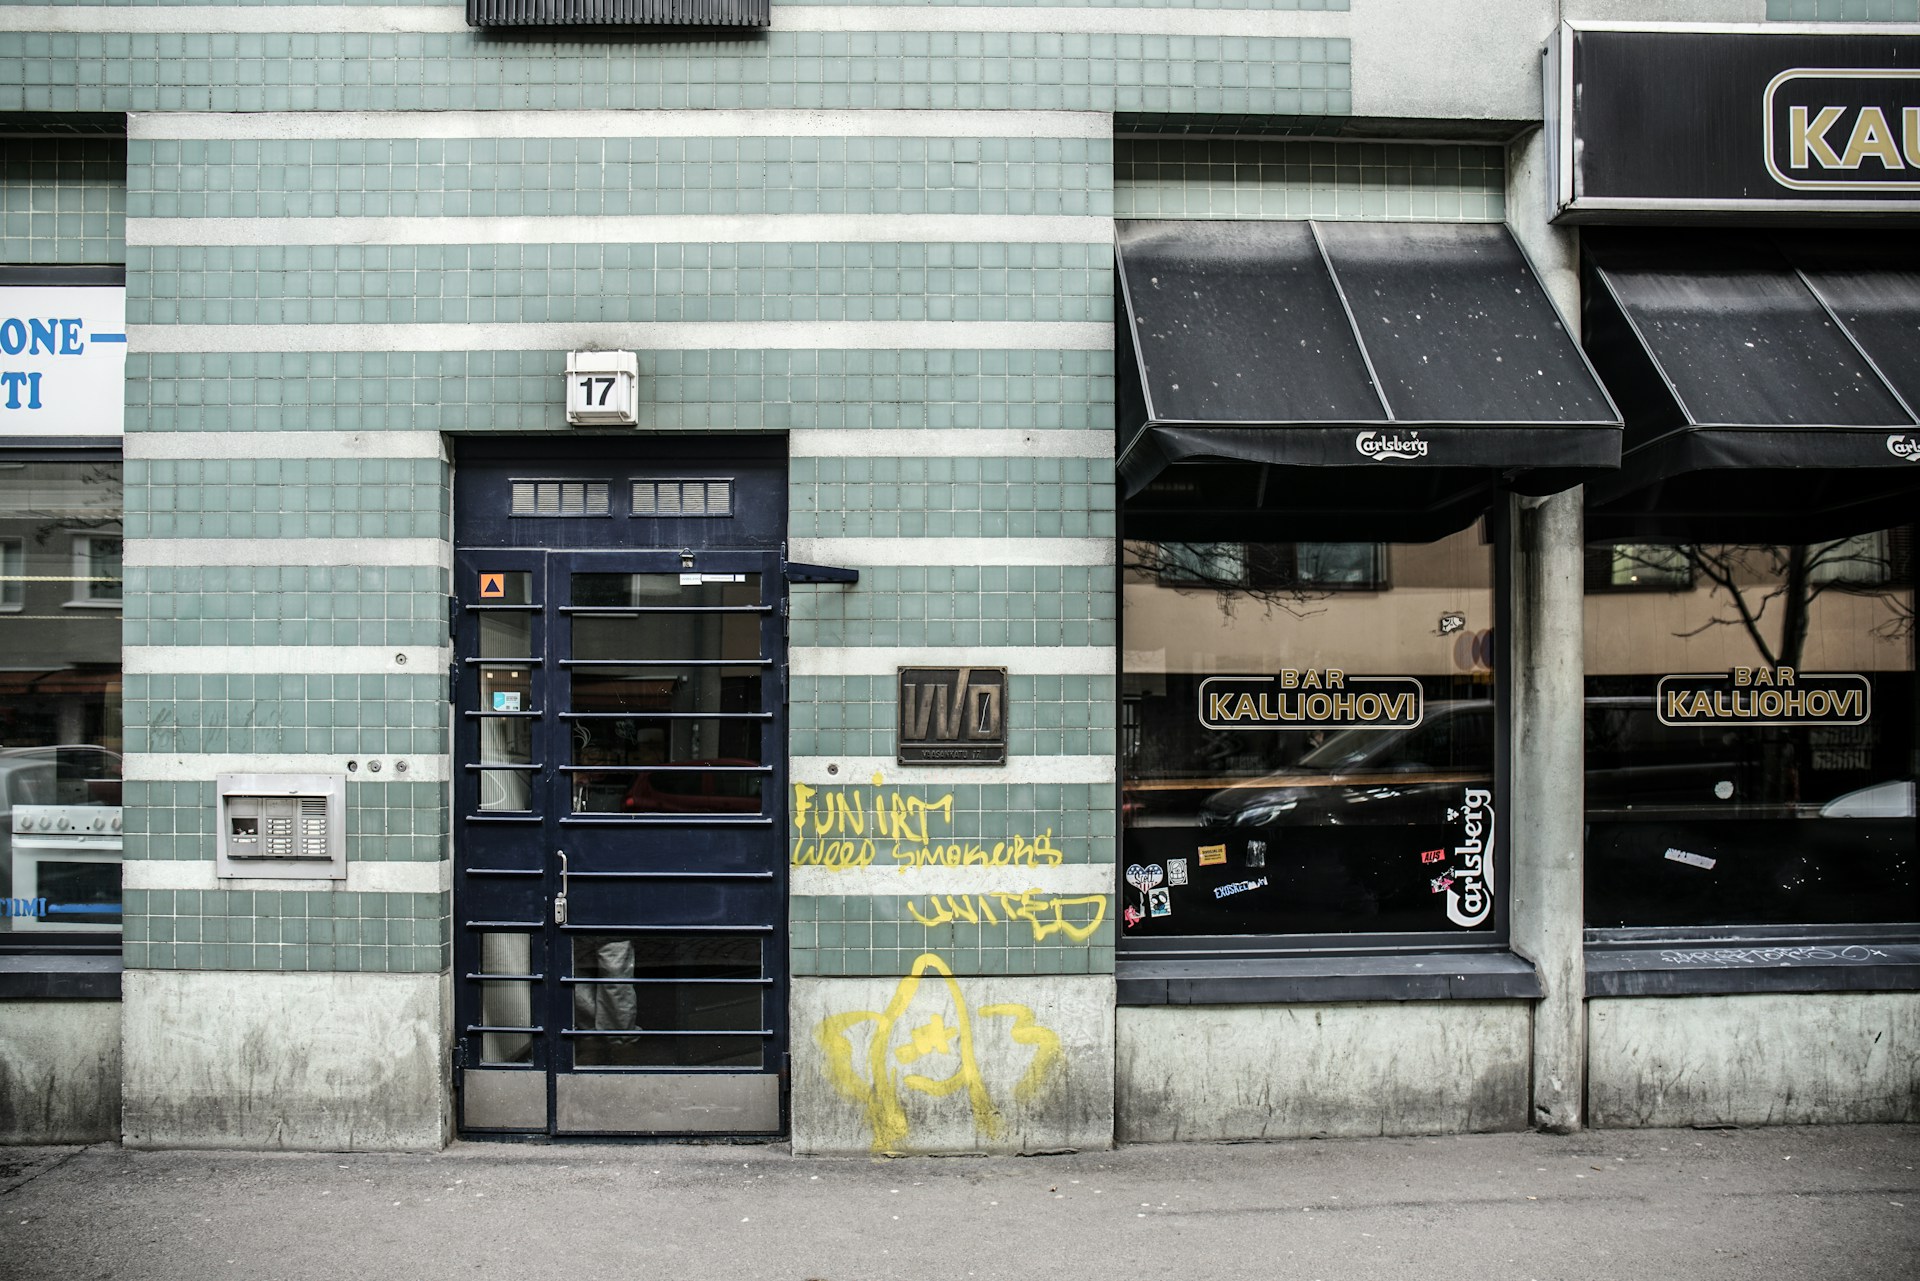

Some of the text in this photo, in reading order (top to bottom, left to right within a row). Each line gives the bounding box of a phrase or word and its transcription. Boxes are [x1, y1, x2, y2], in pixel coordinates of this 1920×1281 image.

[0, 318, 84, 355] ONE
[1, 371, 42, 409] TI
[580, 377, 615, 406] 17
[1356, 431, 1428, 460] Carlsberg
[1281, 669, 1344, 689] BAR
[1735, 666, 1795, 686] BAR
[1210, 693, 1415, 721] KALLIOHOVI
[1667, 690, 1863, 717] KALLIOHOVI
[1447, 788, 1494, 927] Carlsberg
